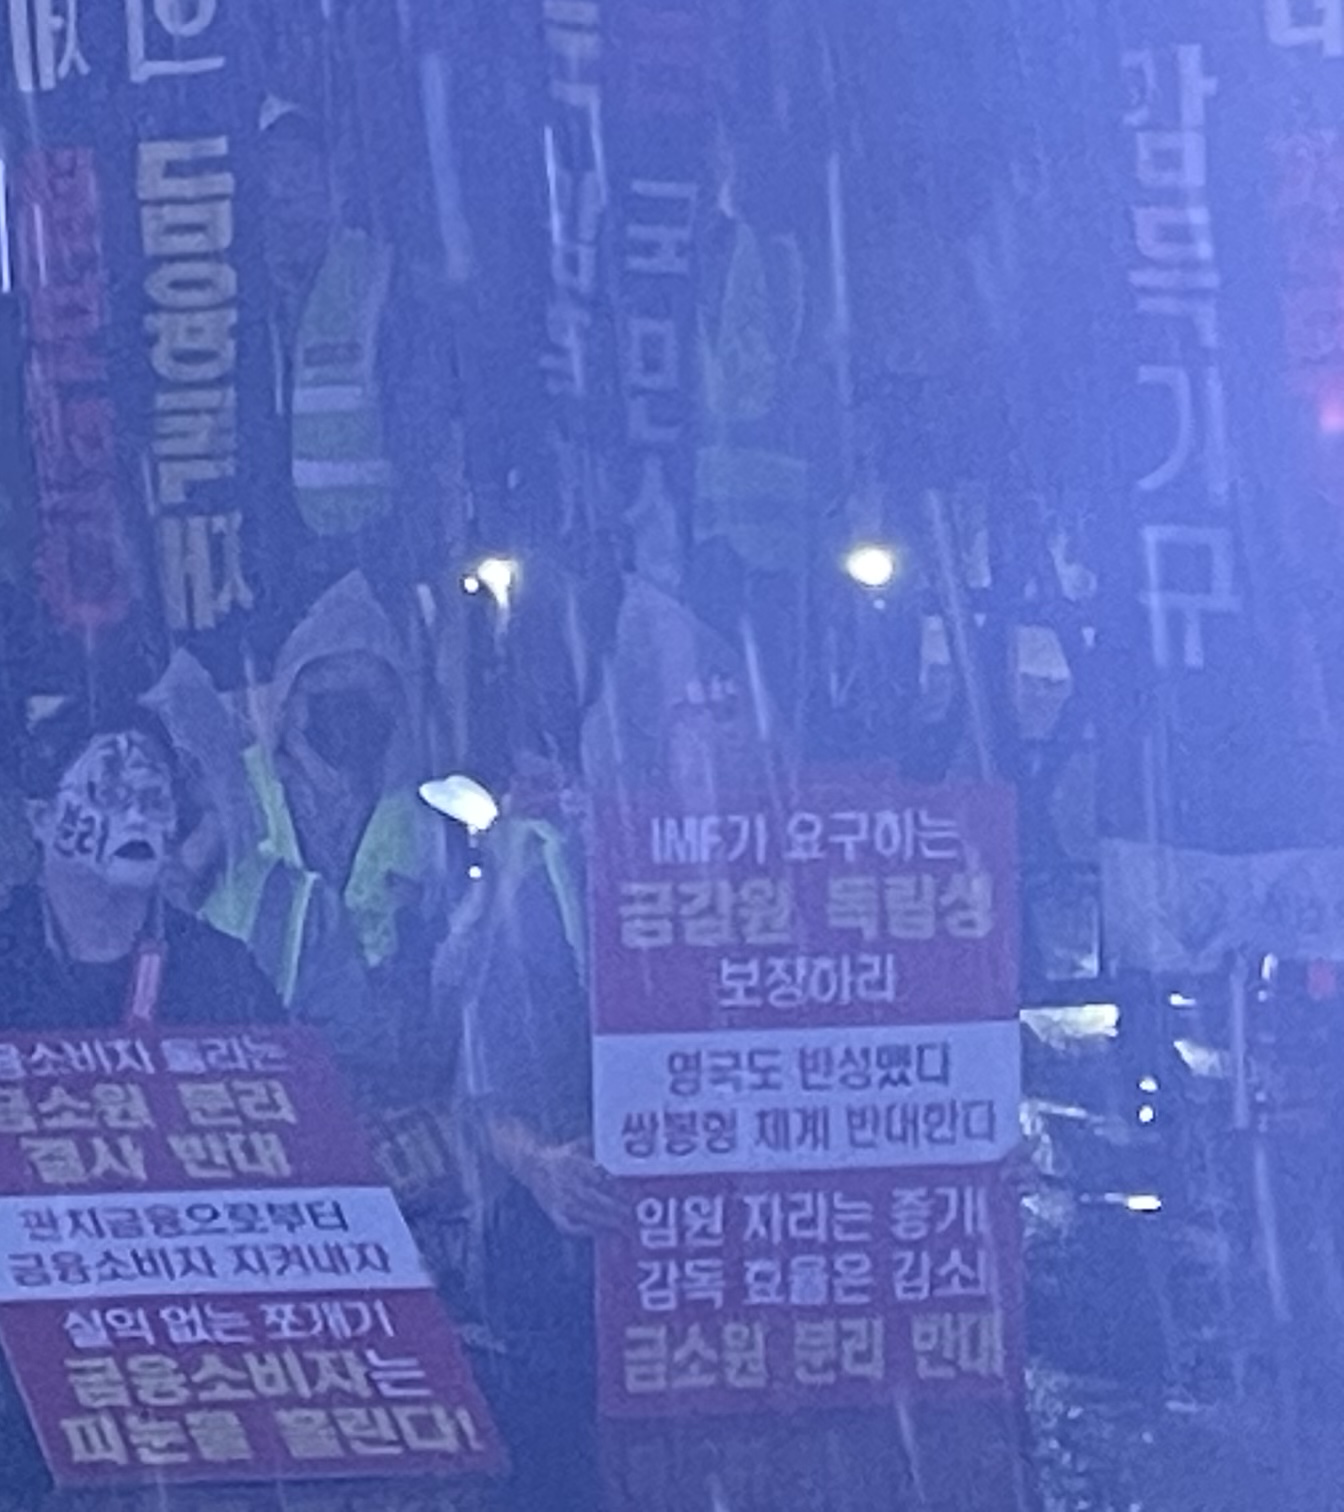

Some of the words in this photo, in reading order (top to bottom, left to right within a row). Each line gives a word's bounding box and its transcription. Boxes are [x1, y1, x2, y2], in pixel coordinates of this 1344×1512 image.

[652, 816, 766, 865] IMF가
[784, 808, 961, 863] 요구하는
[618, 882, 793, 949] 금감원
[824, 876, 994, 938] 독립성
[719, 956, 898, 1009] 보장하라
[176, 1080, 297, 1127] 분리
[166, 1131, 292, 1179] 반대
[636, 1194, 726, 1249] 임원
[743, 1189, 874, 1246] 자리는
[9, 1243, 217, 1290] 금융소비자
[637, 1258, 726, 1311] 감독
[743, 1254, 874, 1307] 효율은
[159, 1301, 255, 1345] 없는
[262, 1298, 394, 1342] 쪼개기
[64, 1347, 432, 1409] 금융소비자는
[624, 1322, 768, 1394] 금소원
